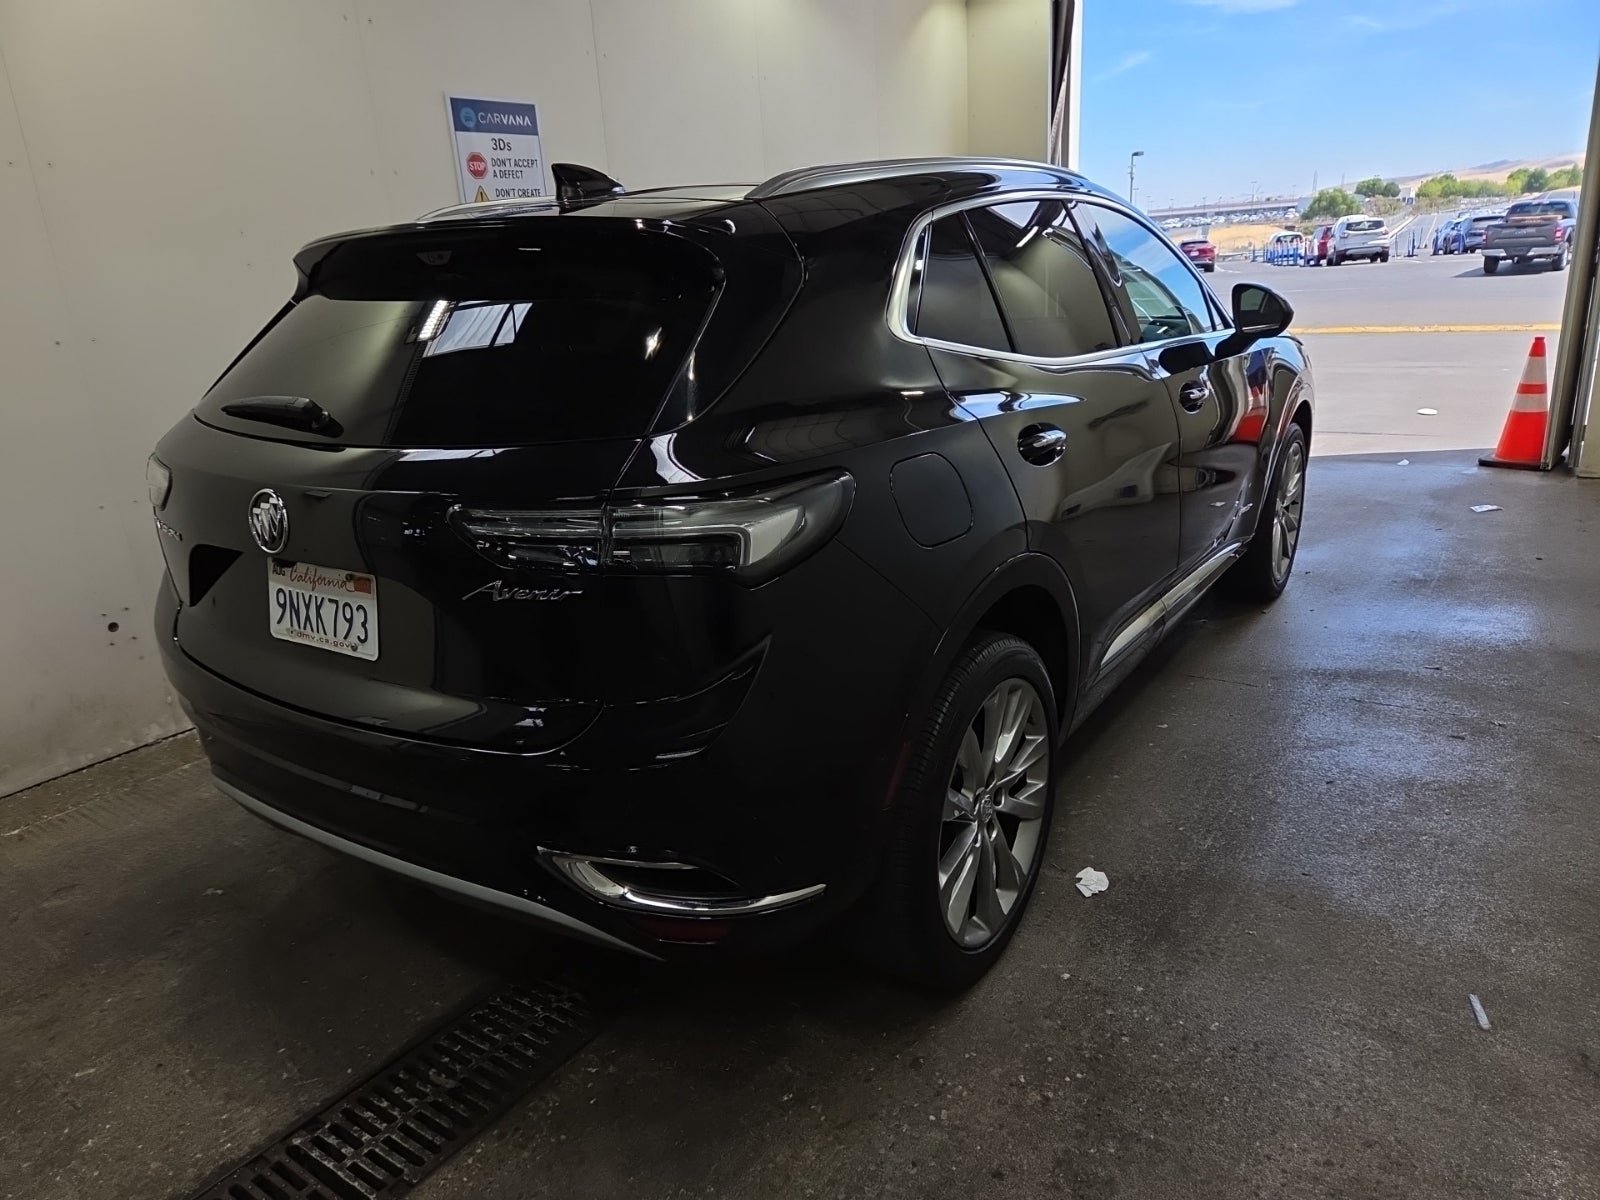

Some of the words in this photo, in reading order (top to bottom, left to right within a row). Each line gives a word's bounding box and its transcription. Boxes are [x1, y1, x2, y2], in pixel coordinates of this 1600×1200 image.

[478, 112, 532, 126] CARVANA
[491, 138, 512, 151] 3Ds
[469, 160, 486, 171] STOP
[491, 158, 512, 167] DON'T
[514, 159, 538, 168] ACCEPT
[493, 170, 498, 178] A
[500, 170, 523, 179] DEFECT
[495, 188, 516, 197] DON'T
[517, 189, 541, 197] CREATE
[289, 565, 355, 592] California
[276, 587, 368, 644] 9NXK793
[296, 632, 351, 648] dmv.ca.gov
